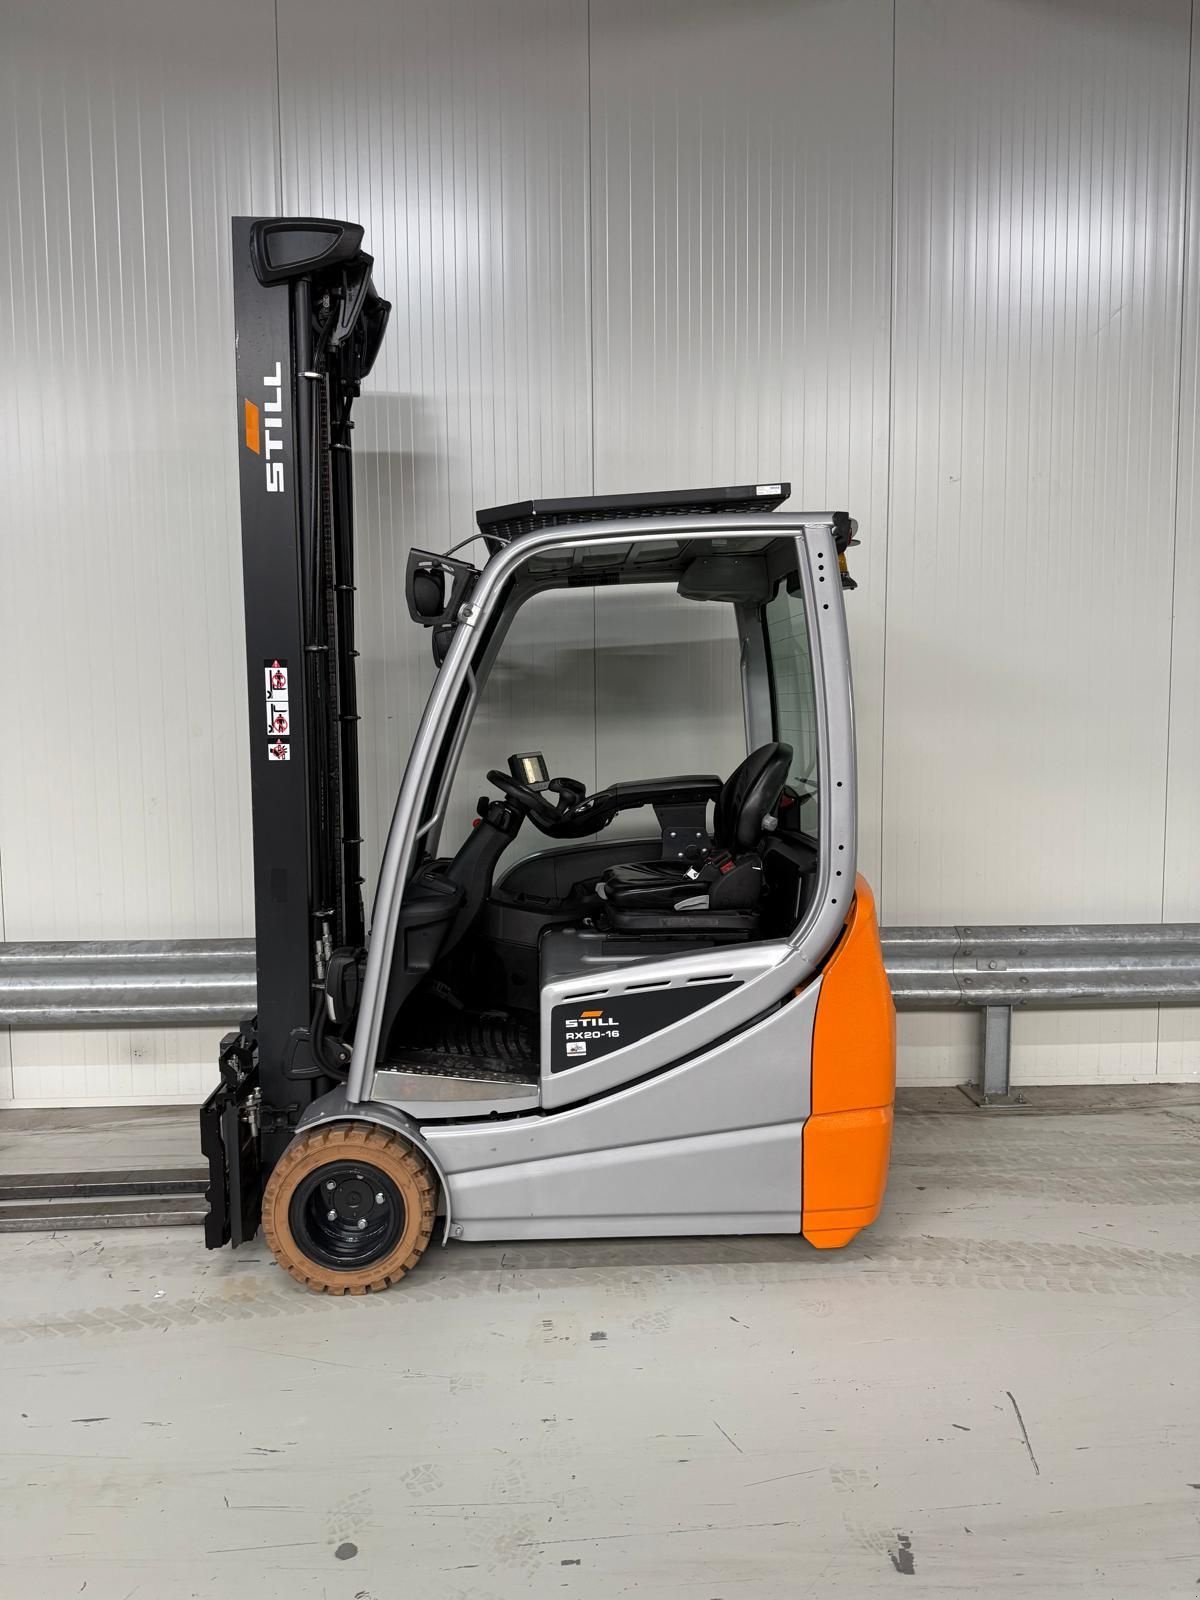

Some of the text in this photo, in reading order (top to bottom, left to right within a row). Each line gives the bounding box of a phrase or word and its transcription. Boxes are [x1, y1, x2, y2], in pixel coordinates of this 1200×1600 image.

[263, 361, 285, 493] STILL
[565, 1017, 620, 1028] STILL
[565, 1030, 620, 1040] RX20-16
